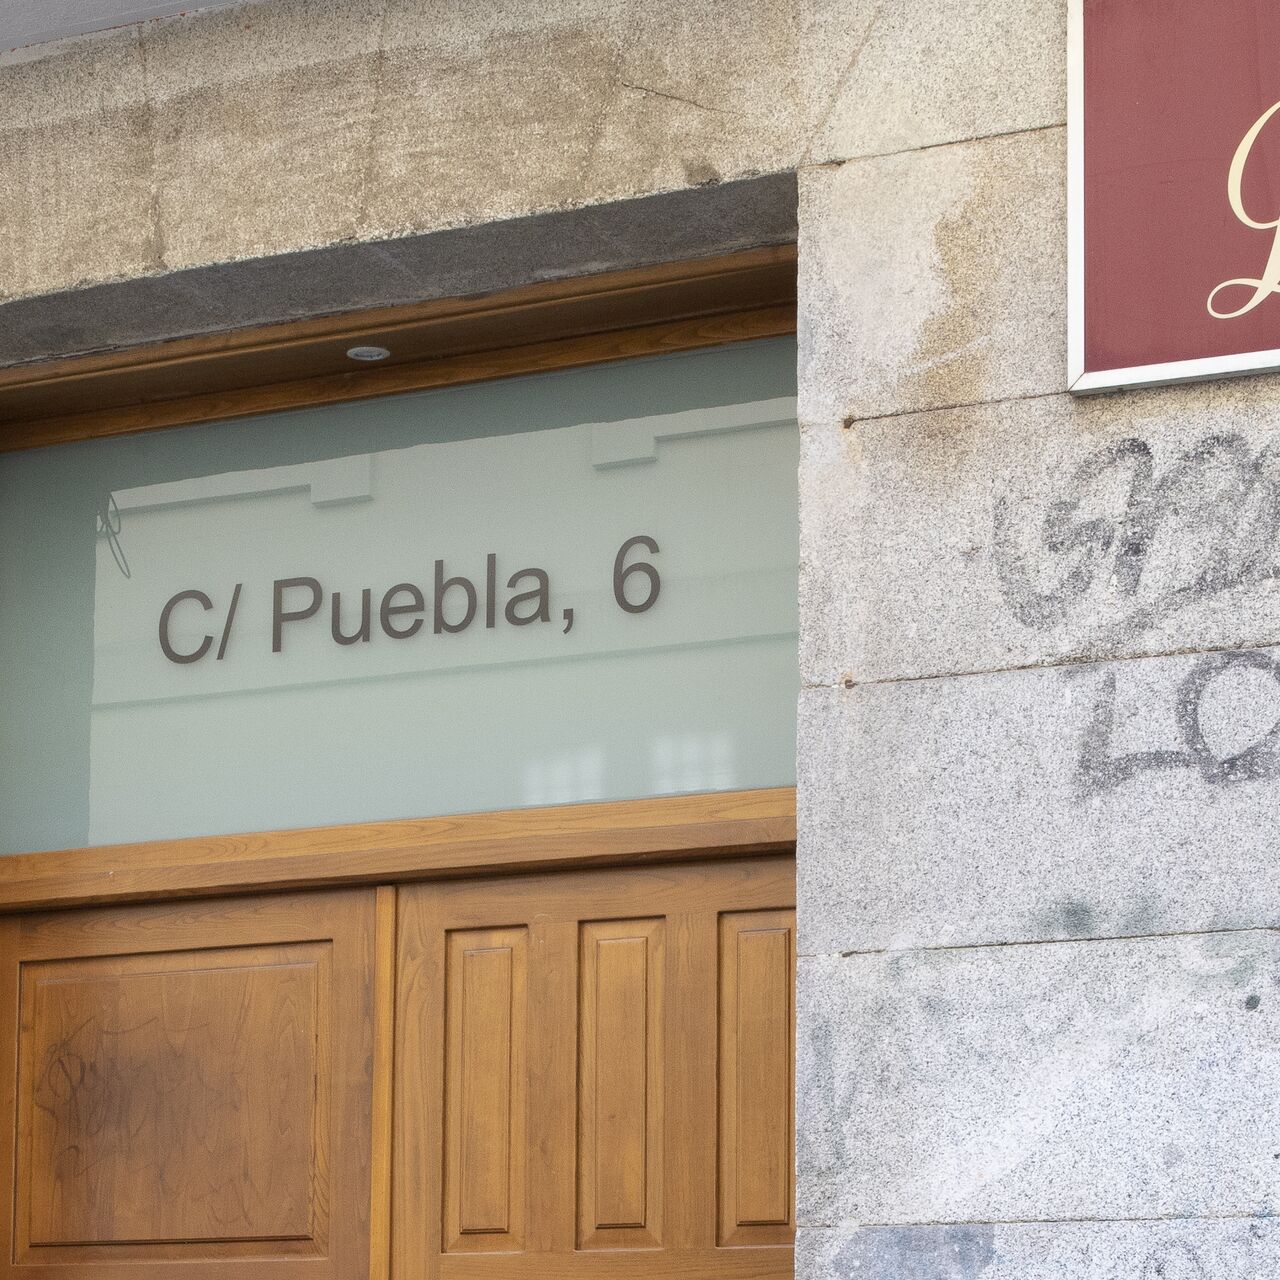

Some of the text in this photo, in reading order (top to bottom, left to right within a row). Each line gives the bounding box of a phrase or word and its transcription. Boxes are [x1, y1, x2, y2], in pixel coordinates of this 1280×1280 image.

[157, 535, 662, 666] C/ Puebla, 6
